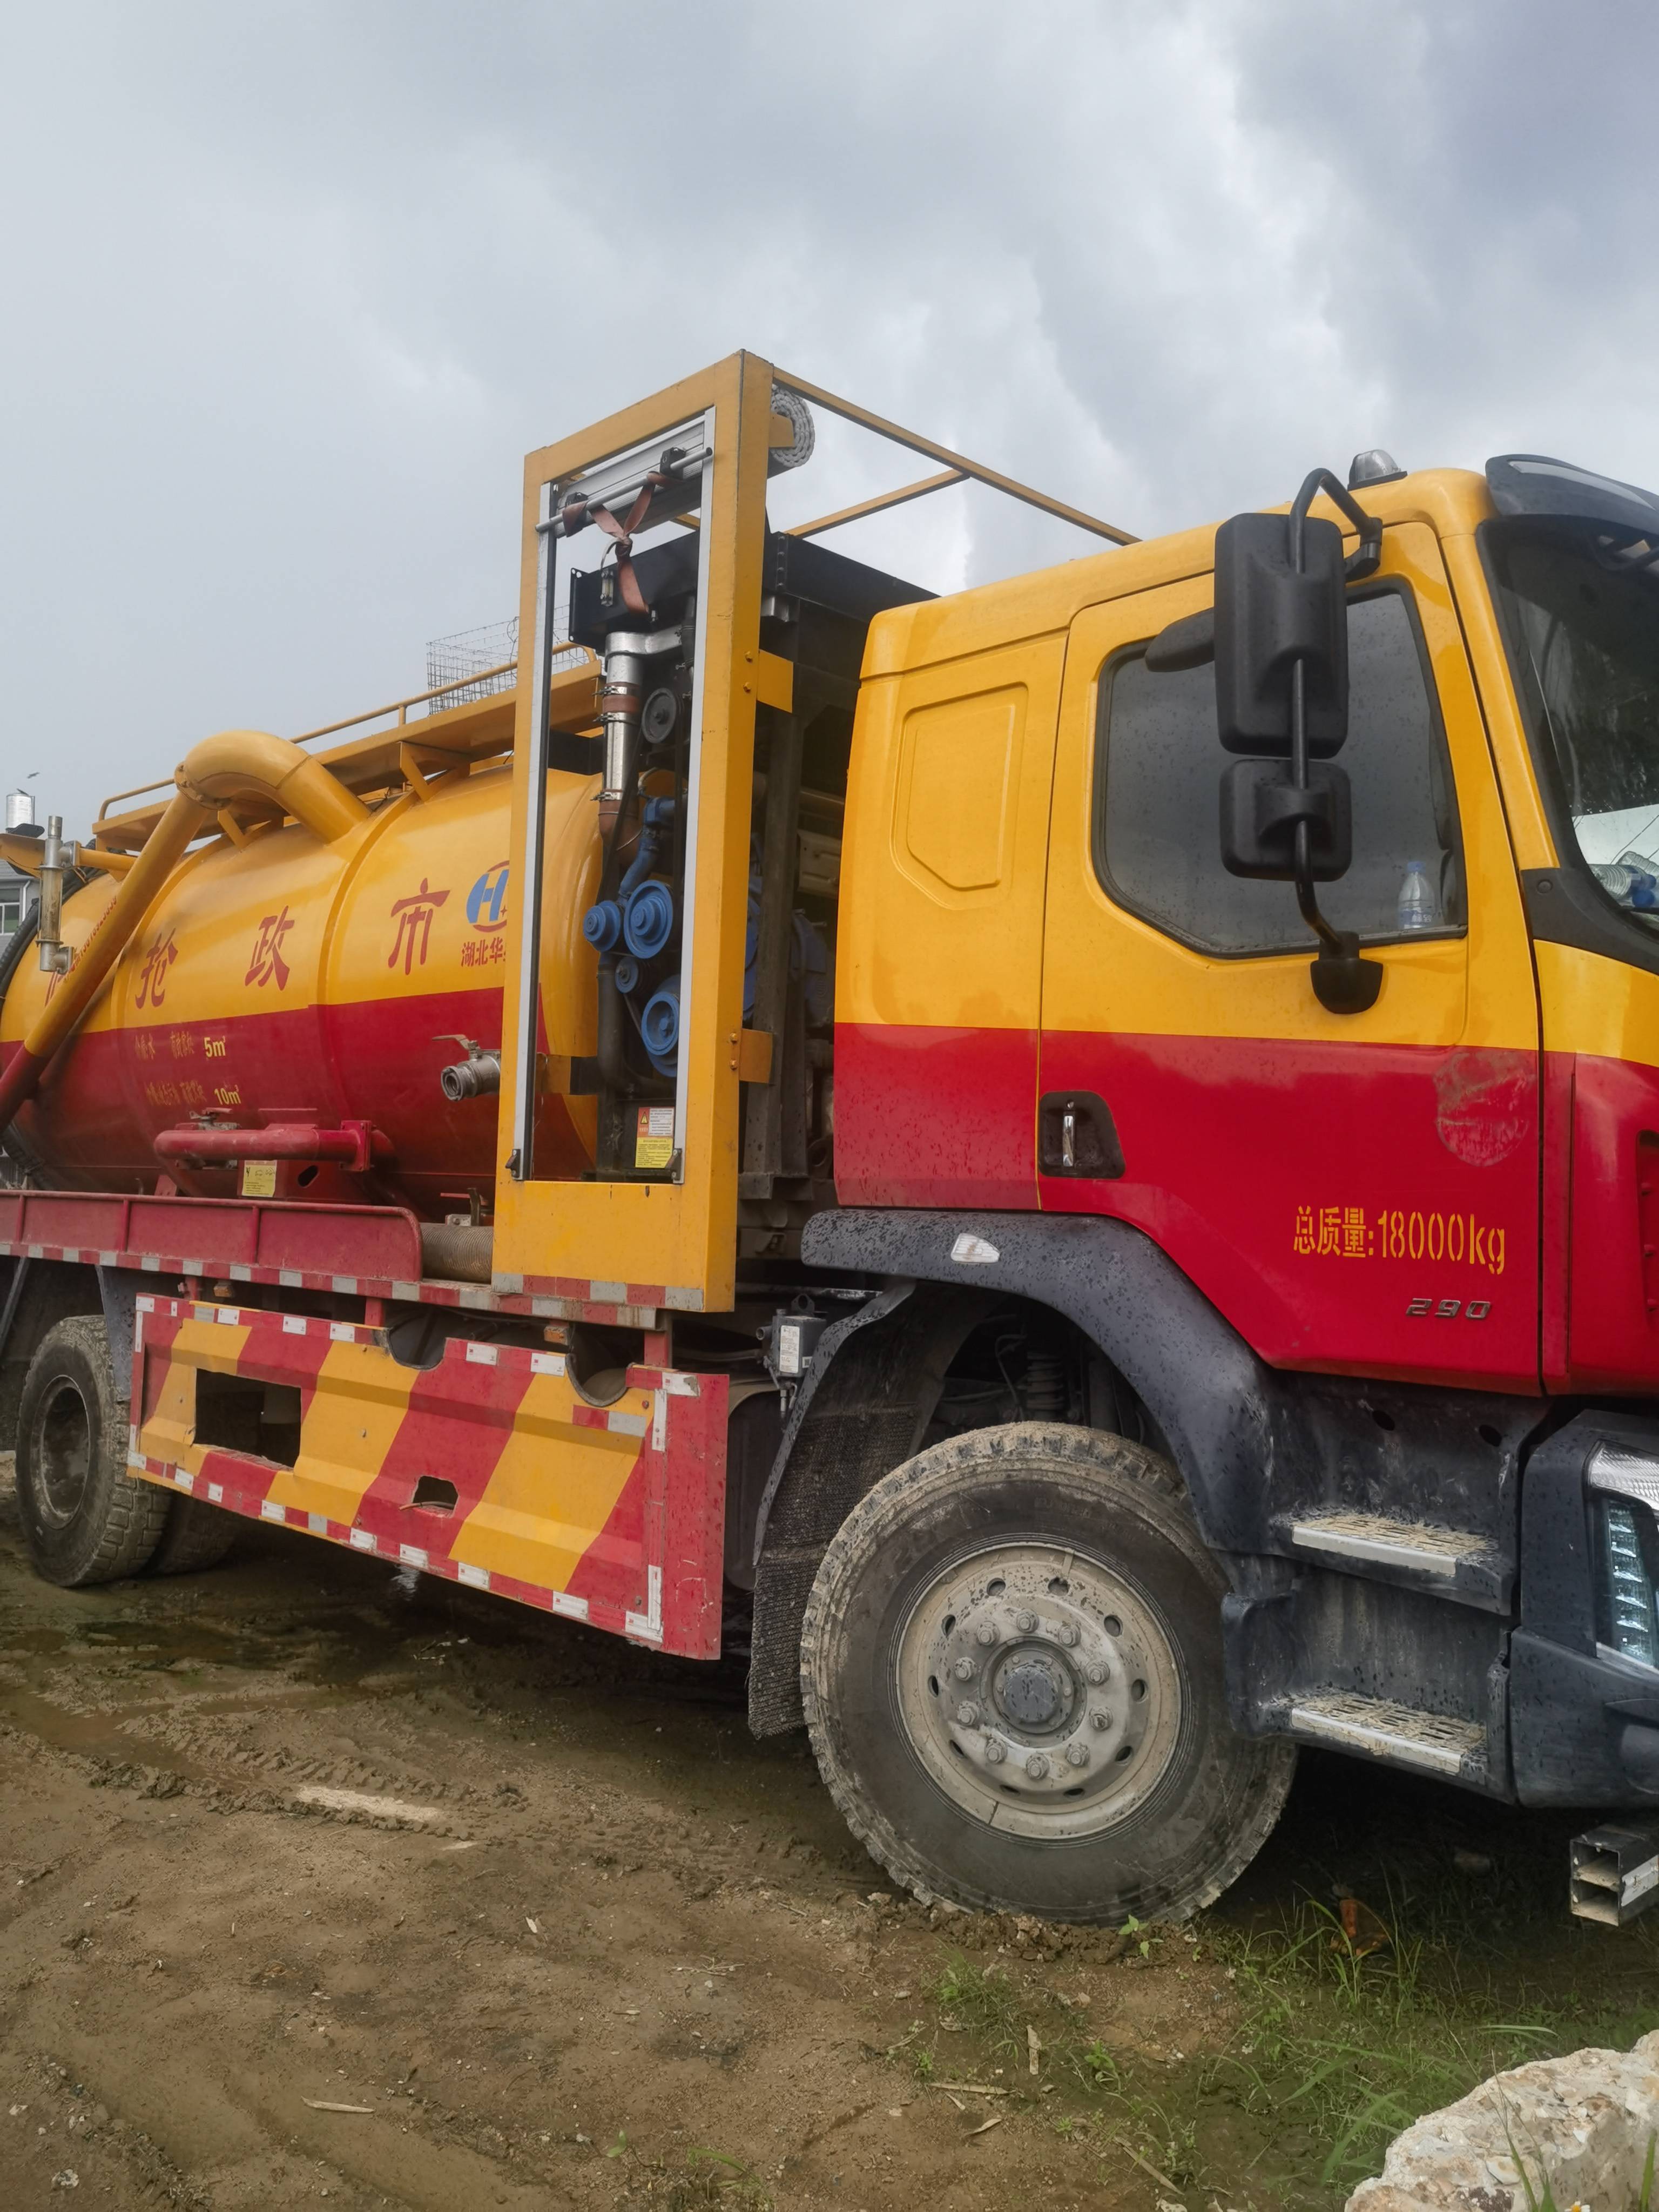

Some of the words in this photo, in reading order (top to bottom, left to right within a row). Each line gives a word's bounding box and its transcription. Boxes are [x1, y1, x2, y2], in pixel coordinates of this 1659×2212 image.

[245, 905, 295, 991] 政
[388, 877, 451, 975] 市
[461, 936, 506, 967] 湖北华
[1405, 1298, 1492, 1320] 290
